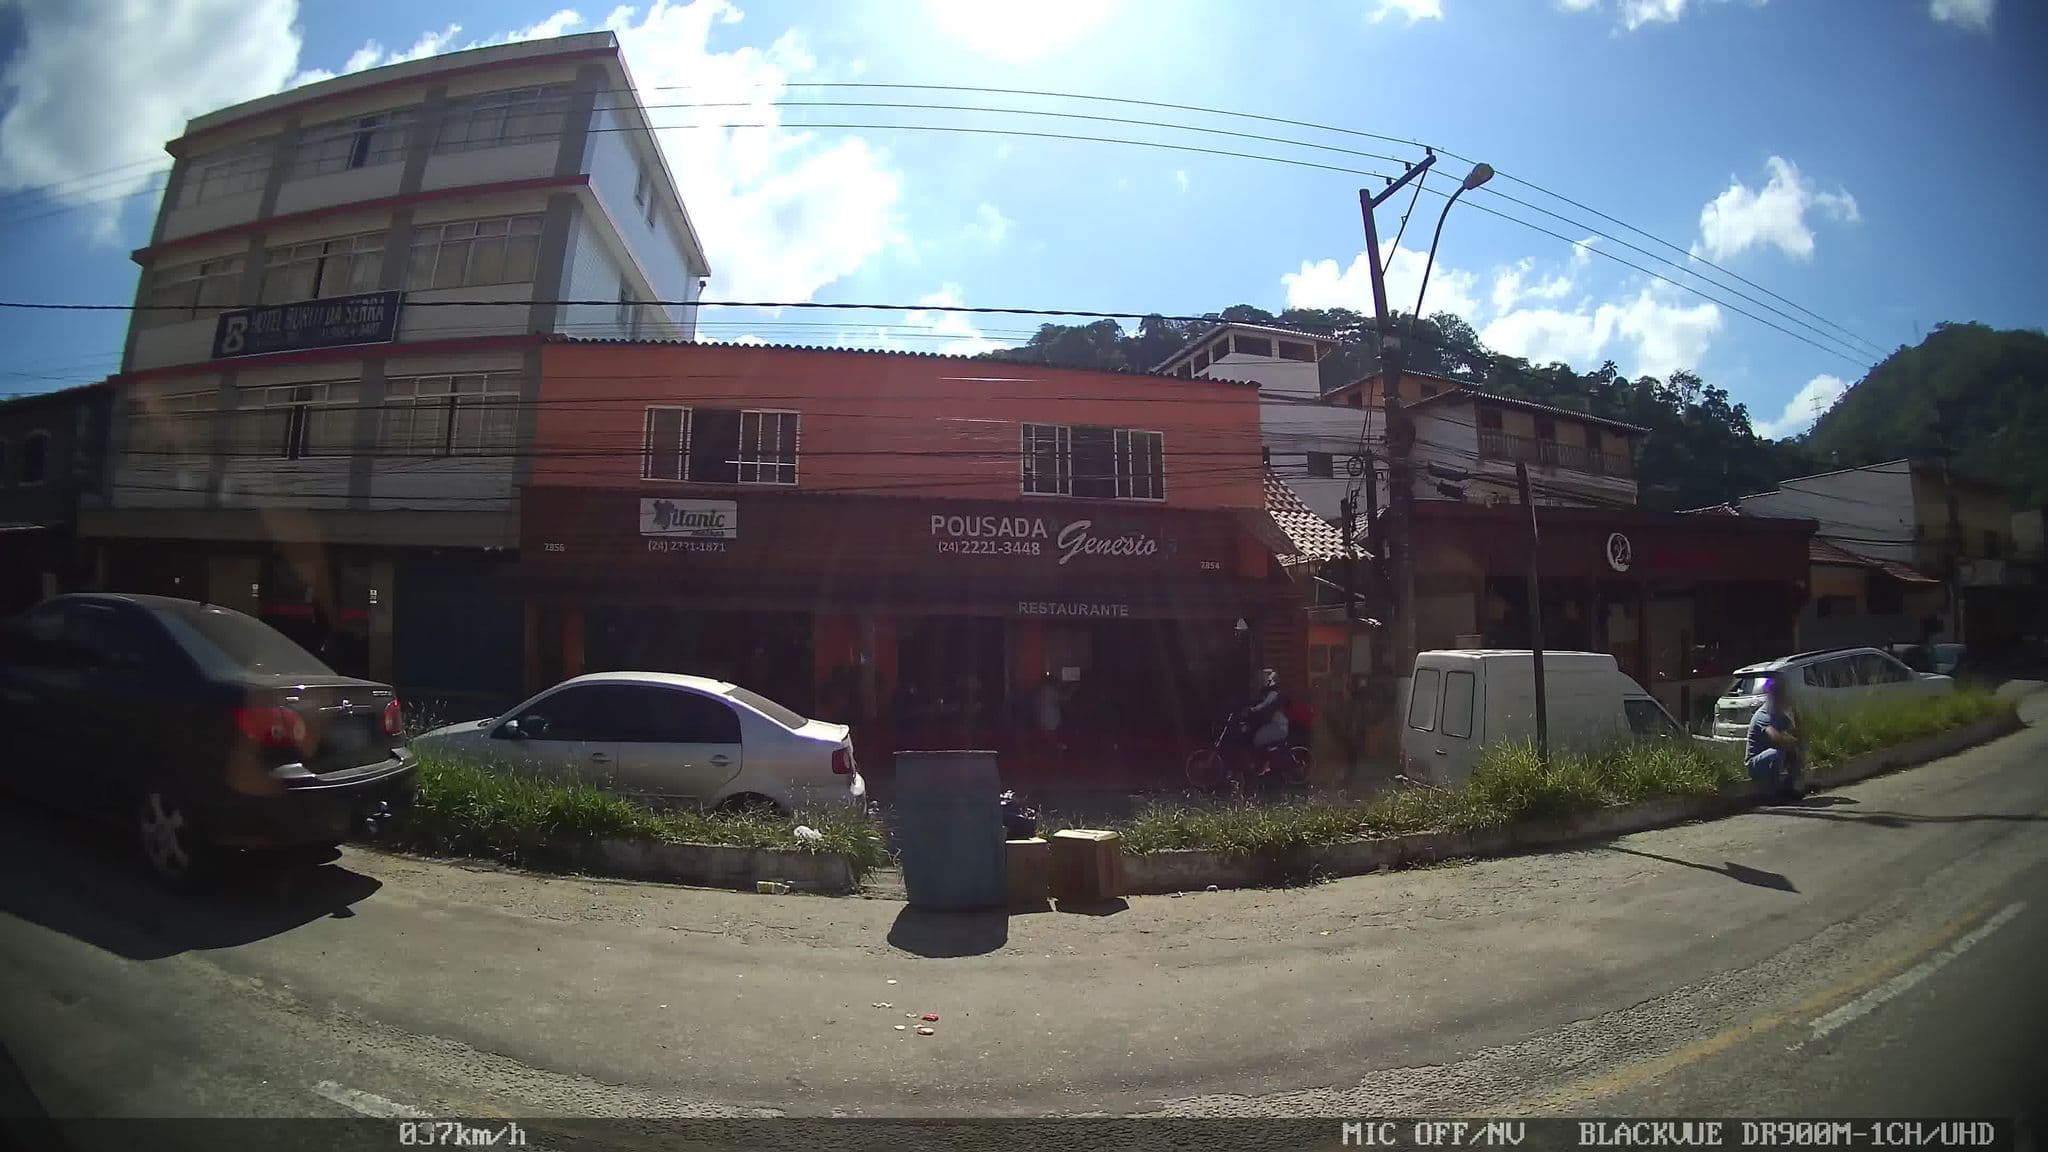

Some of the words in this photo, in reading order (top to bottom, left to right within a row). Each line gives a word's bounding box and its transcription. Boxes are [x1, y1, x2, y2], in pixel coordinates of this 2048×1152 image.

[931, 515, 1048, 538] POUSADA
[938, 541, 959, 553] (24)
[961, 540, 1041, 555] 2221-3448
[1018, 602, 1129, 616] RESTAURANTE
